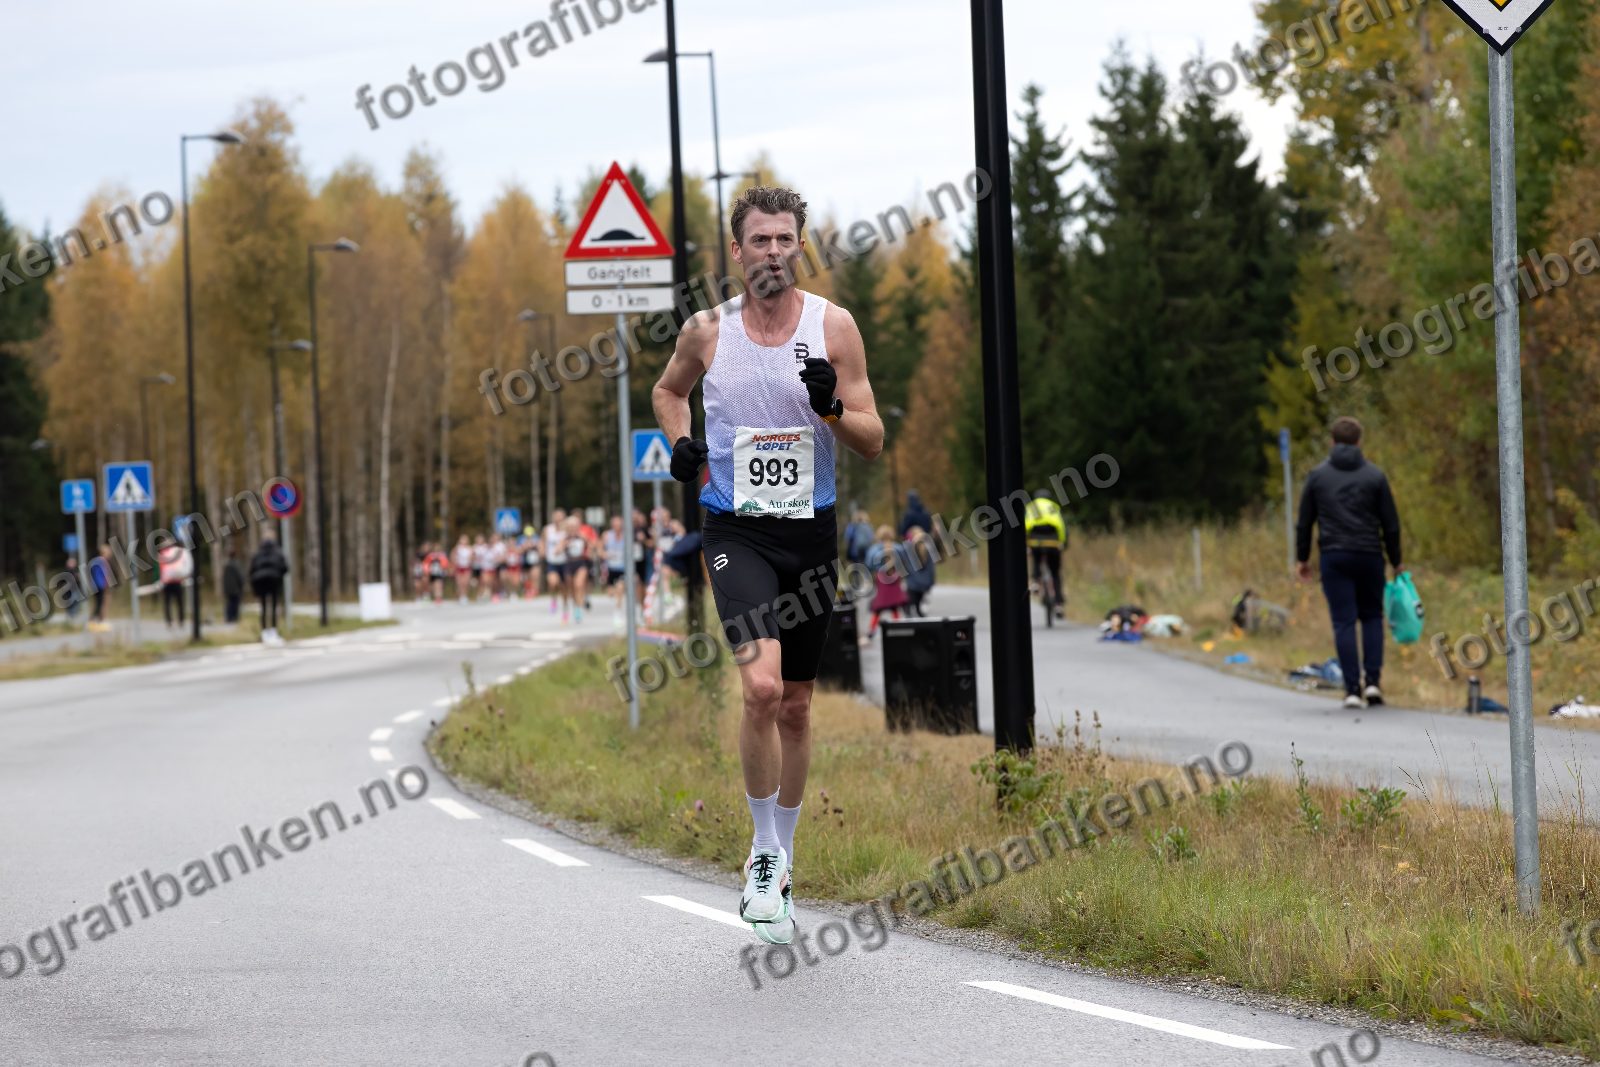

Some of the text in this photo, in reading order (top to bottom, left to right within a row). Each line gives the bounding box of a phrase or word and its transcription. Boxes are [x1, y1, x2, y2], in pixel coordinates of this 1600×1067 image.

[587, 266, 651, 280] Gangfelt
[752, 432, 801, 443] NORGES
[756, 442, 794, 451] LØPET
[749, 457, 799, 487] 993
[768, 498, 810, 509] Aurskog
